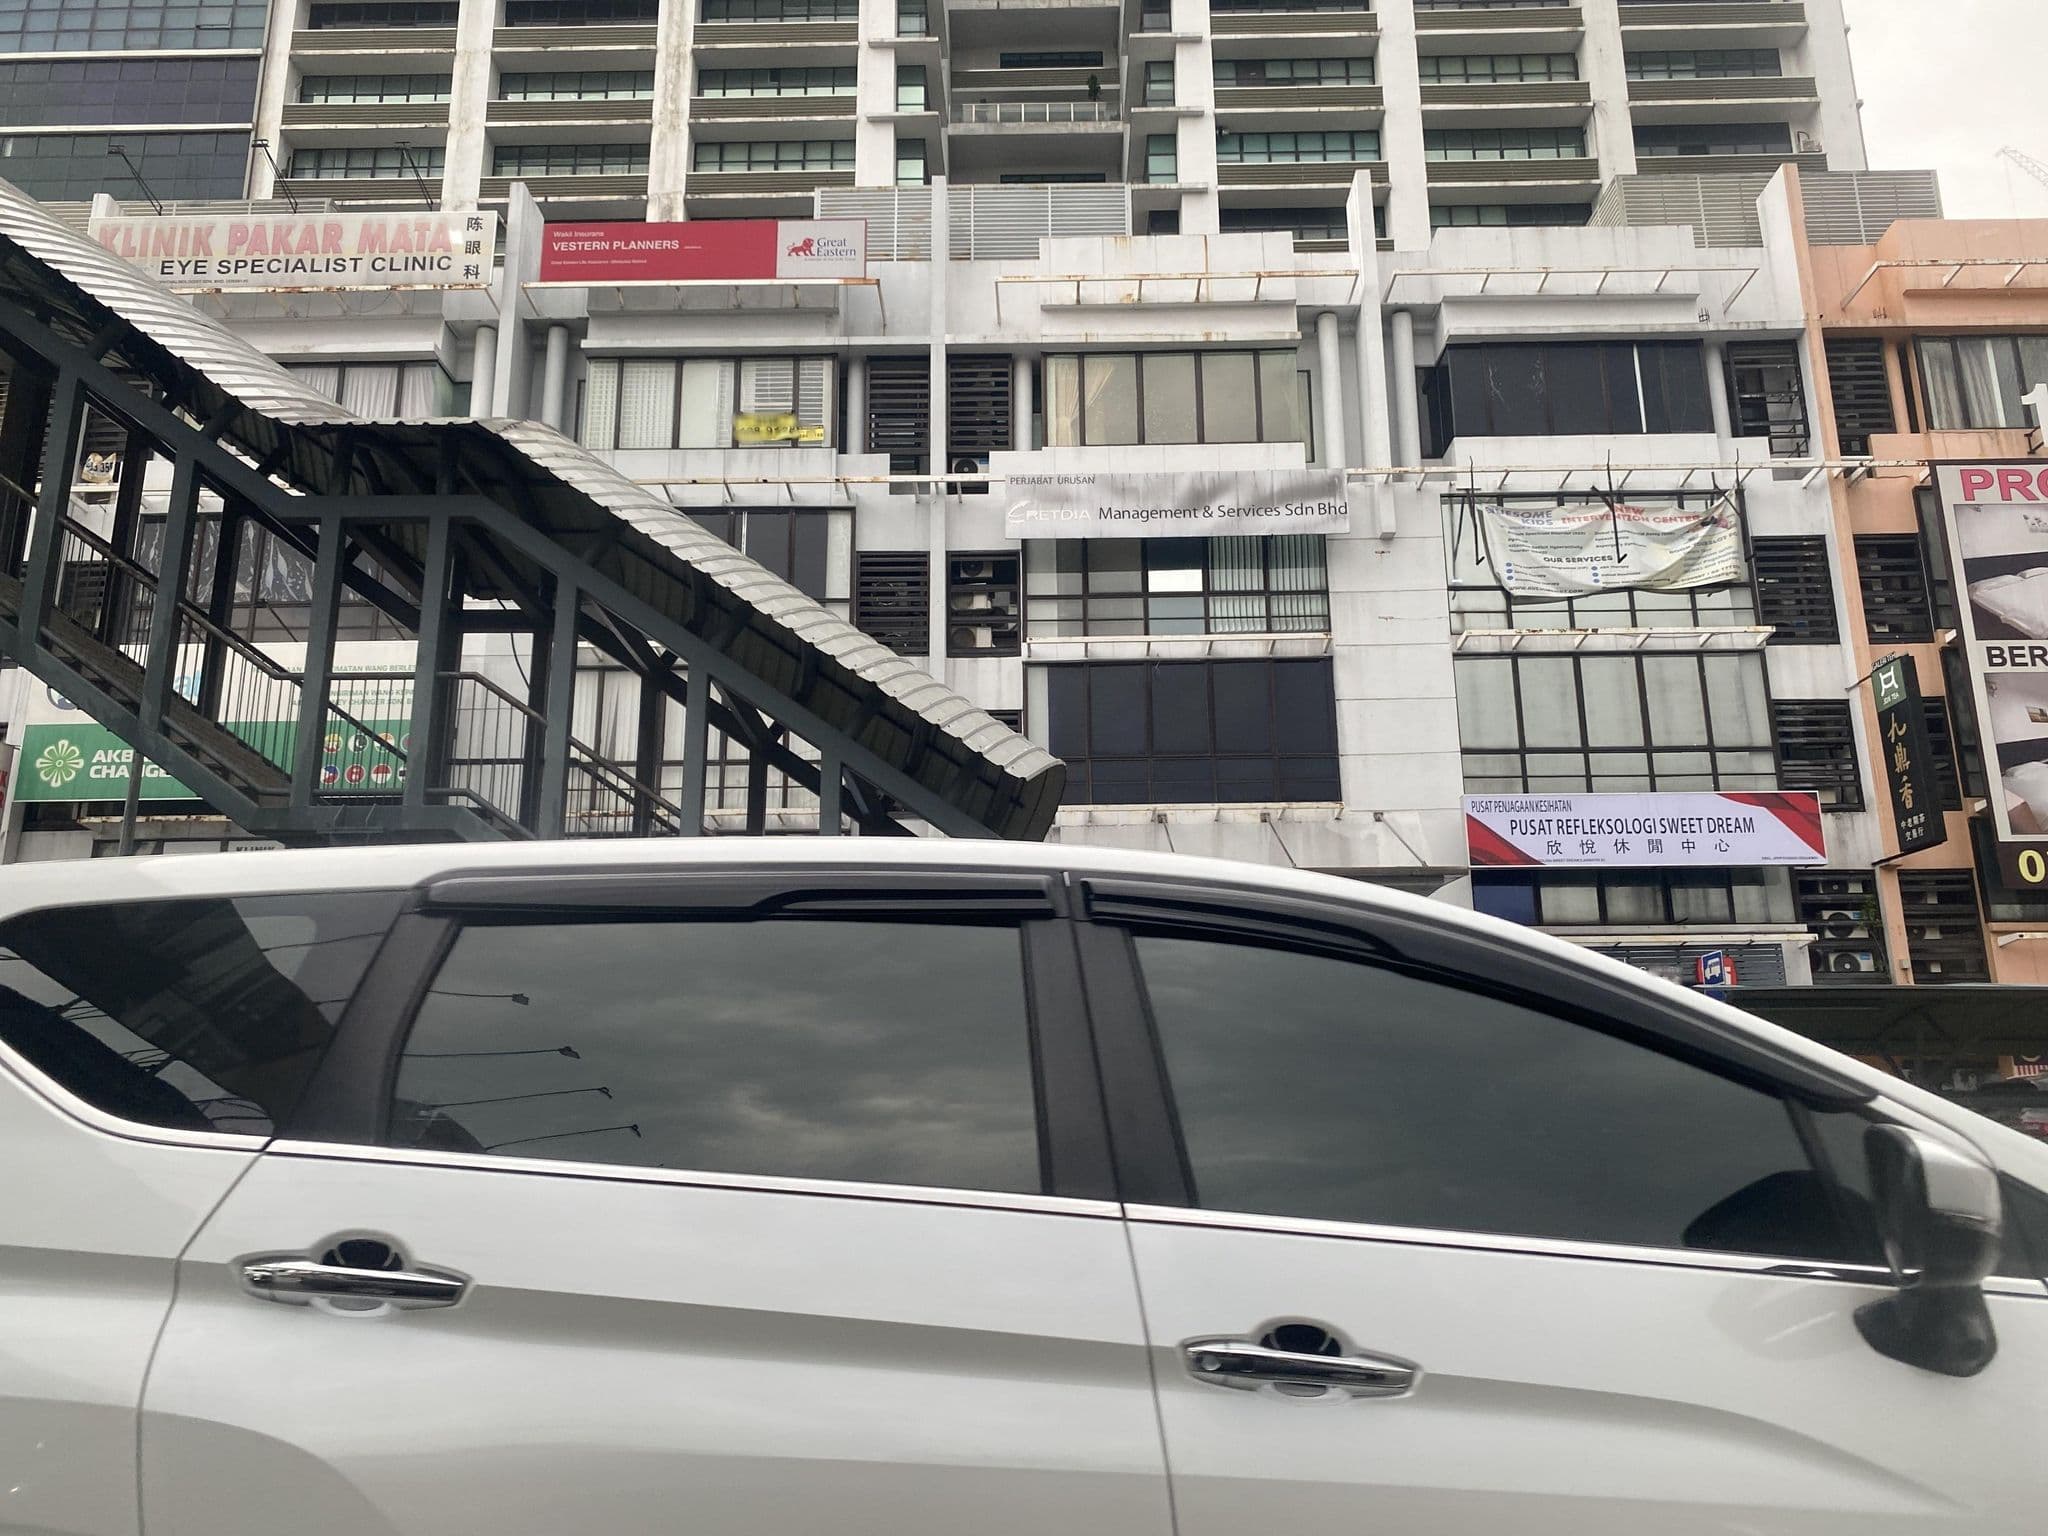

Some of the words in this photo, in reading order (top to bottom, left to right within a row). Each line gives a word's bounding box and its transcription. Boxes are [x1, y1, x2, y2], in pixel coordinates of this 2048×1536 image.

[99, 224, 215, 257] KLINIK
[227, 223, 343, 256] PAKAR
[357, 221, 453, 254] MATA
[553, 241, 609, 251] VESTERN
[613, 240, 679, 250] PLANNERS
[817, 237, 847, 247] Great
[463, 217, 483, 279] 陈眼科
[817, 247, 856, 257] Eastern
[160, 259, 208, 275] EYE
[217, 257, 362, 274] SPECIALIST
[371, 256, 452, 272] CLINIC
[1057, 475, 1095, 484] URUSAN
[1099, 507, 1198, 522] Management
[1203, 505, 1213, 518] &
[1218, 504, 1281, 518] Services
[1285, 503, 1314, 516] Sdn
[1318, 502, 1348, 515] Bhd
[1566, 555, 1613, 563] SERVICES
[1471, 800, 1492, 813] PUSAT
[1535, 800, 1572, 812] KESIHATAN
[1511, 819, 1552, 835] PUSAT
[1557, 818, 1656, 835] REFLEKSOLOGI
[1660, 817, 1703, 834] SWEET
[1708, 817, 1755, 833] DREAM
[2019, 849, 2048, 883] 0
